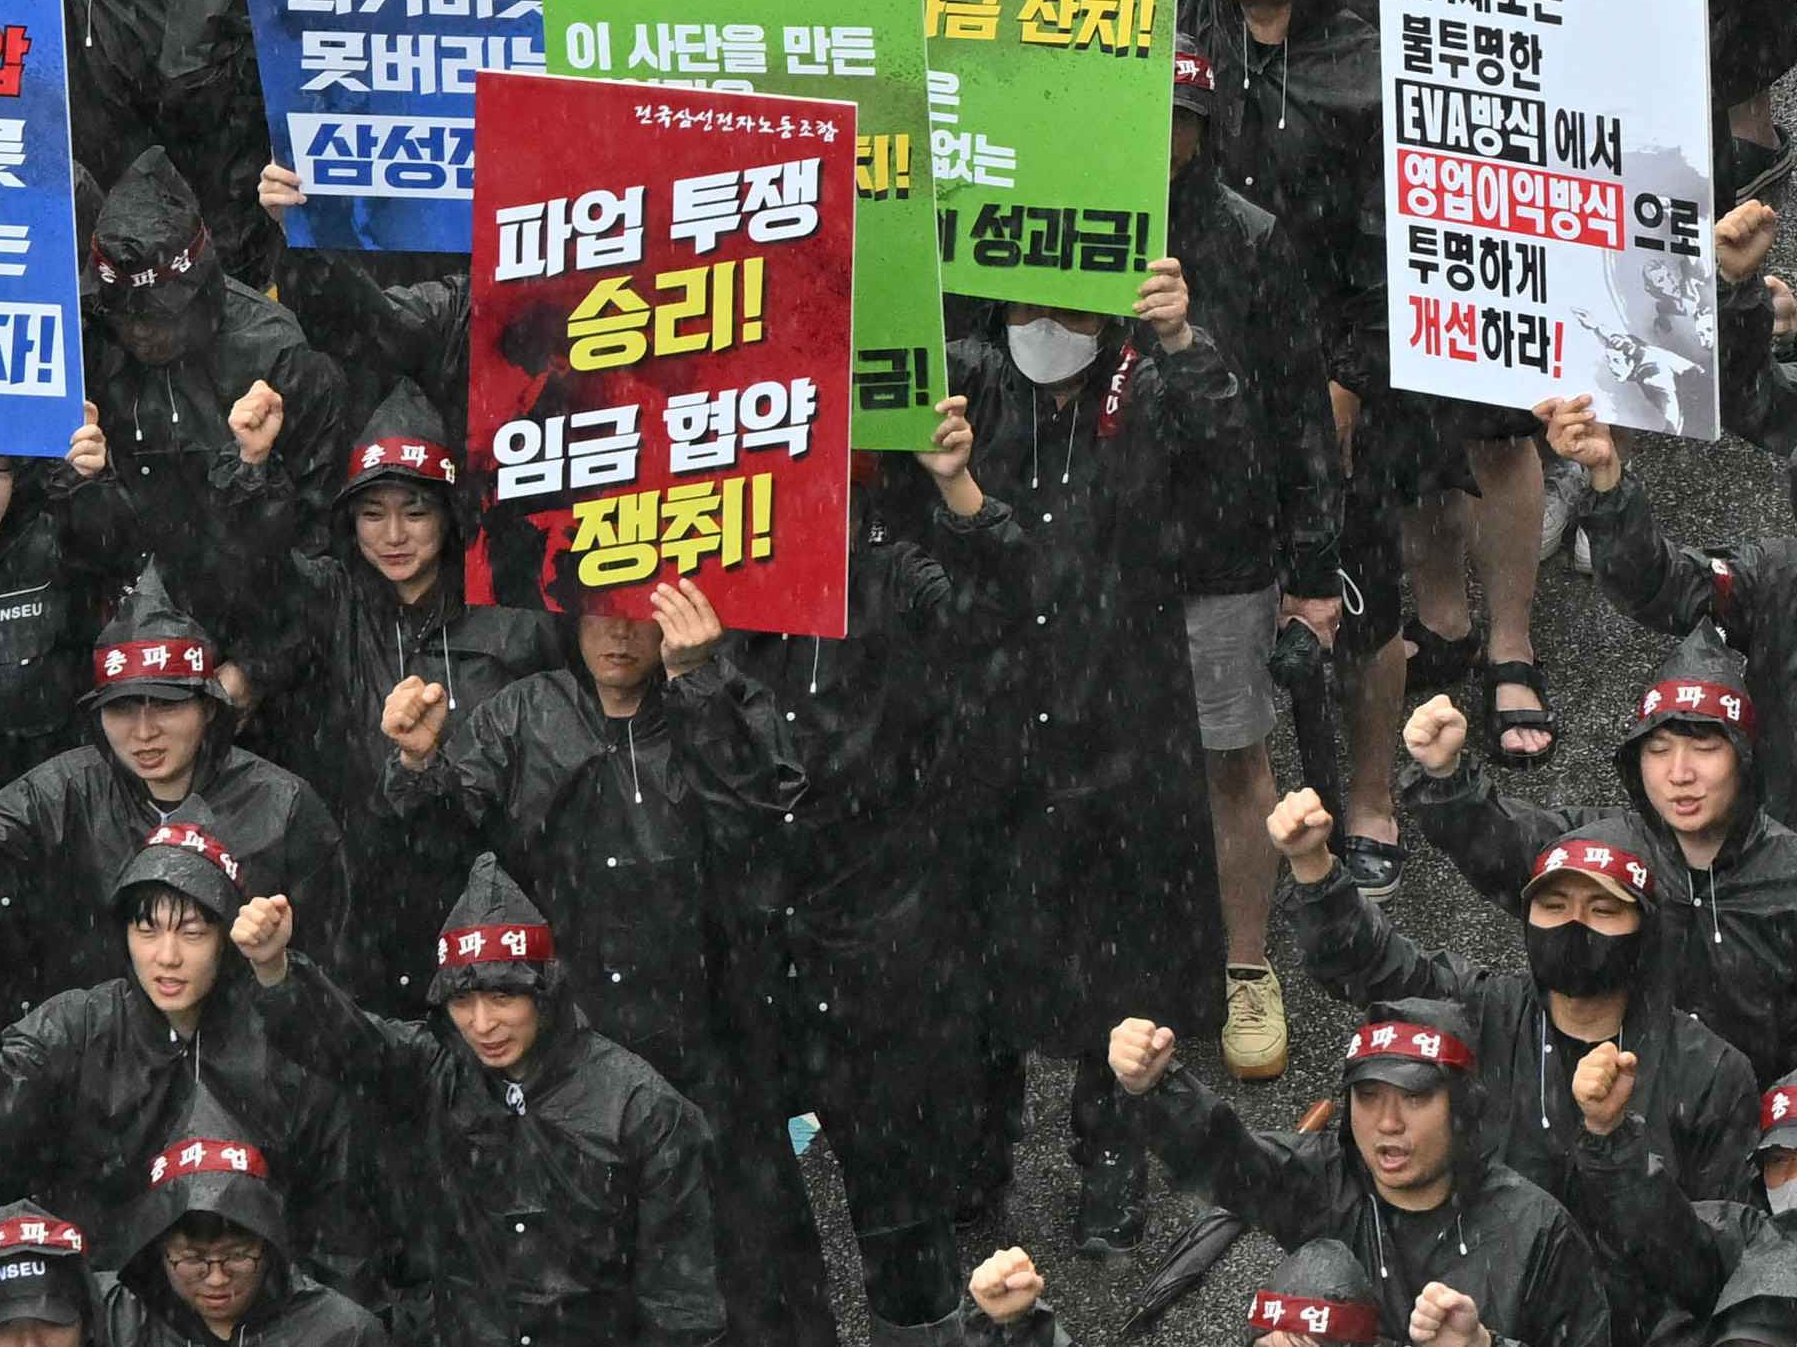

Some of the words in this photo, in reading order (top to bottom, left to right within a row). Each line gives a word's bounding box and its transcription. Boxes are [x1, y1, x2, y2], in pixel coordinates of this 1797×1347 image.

[1402, 14, 1543, 92] 불투명한
[496, 185, 646, 281] 파업
[671, 158, 820, 254] 투쟁
[970, 208, 1147, 272] 성과금!
[1408, 225, 1546, 303] 투명하게
[567, 257, 765, 370] 승리!
[1409, 295, 1564, 378] 개선하라!
[492, 404, 640, 500] 임금
[663, 378, 817, 473] 협약
[571, 472, 772, 586] 쟁취!
[0, 602, 42, 621] NSEU
